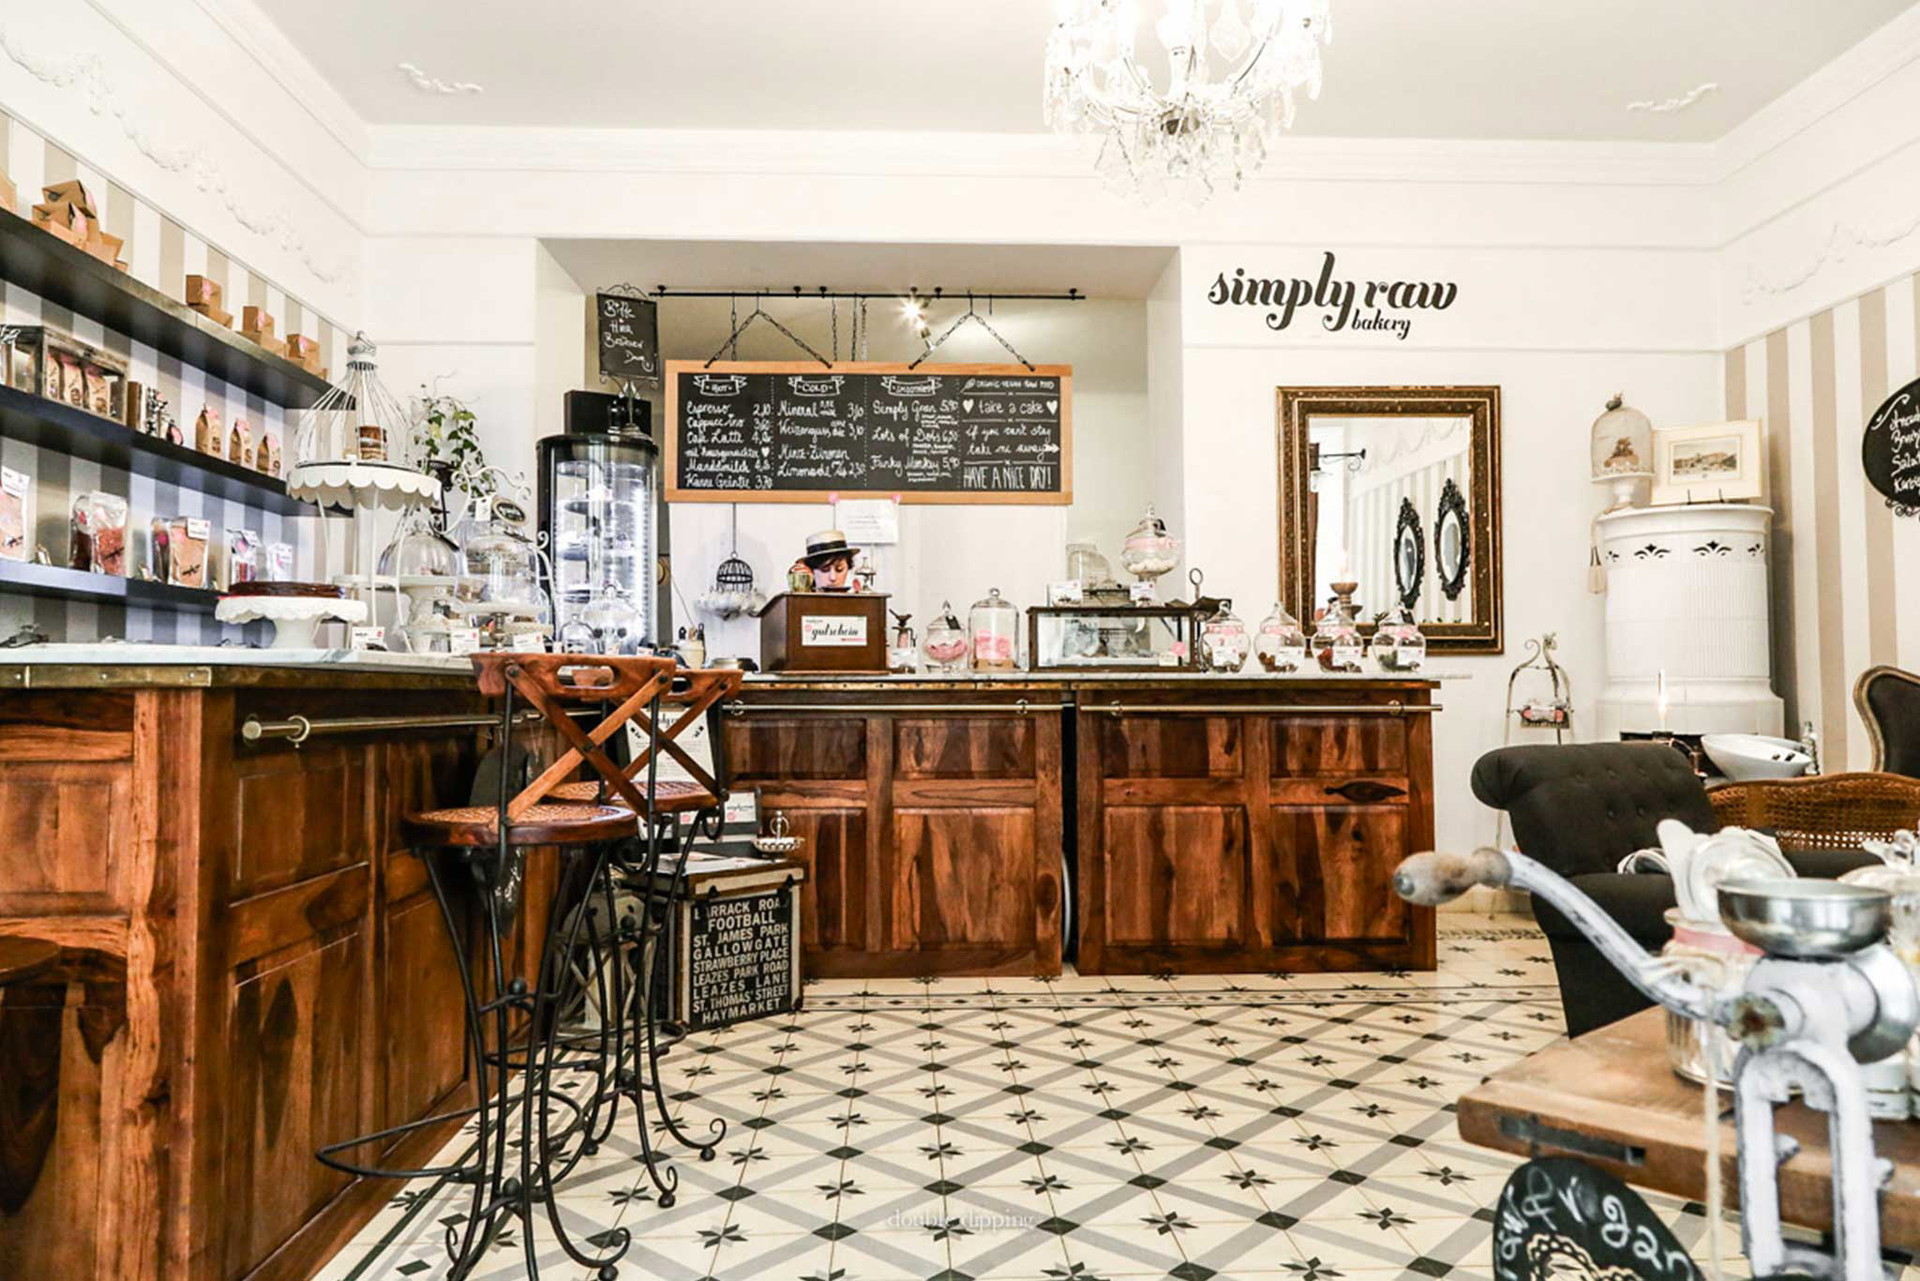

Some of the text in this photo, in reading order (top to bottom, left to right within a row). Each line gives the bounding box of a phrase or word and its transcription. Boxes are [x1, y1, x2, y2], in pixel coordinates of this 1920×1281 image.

[1208, 251, 1458, 332] simply raw
[1351, 308, 1412, 341] bakery
[802, 383, 828, 393] COLD
[686, 400, 732, 419] Espresso
[777, 400, 819, 418] Mineral
[872, 400, 908, 421] Simply
[978, 400, 1045, 414] take a cake
[872, 426, 895, 442] Lots
[898, 427, 909, 448] of
[965, 425, 978, 441] if
[981, 428, 1000, 442] you
[1030, 424, 1052, 444] stay
[967, 443, 992, 456] take
[994, 444, 1012, 454] me
[1016, 443, 1047, 463] away
[963, 465, 989, 489] HAVE
[991, 465, 1002, 489] A
[1003, 465, 1025, 489] NICE
[1029, 465, 1051, 490] DAY!
[758, 898, 785, 911] ROA
[708, 911, 775, 932] FOOTBALL
[693, 923, 788, 947] ST. JAMES PARK
[693, 935, 789, 960] GALLOWGATE
[693, 946, 789, 974] STRAWBERRY PLACE
[693, 960, 789, 987] LEAZES PARK ROAD
[693, 972, 789, 1000] LEAZES LANE
[693, 1000, 708, 1013] ST.
[755, 984, 788, 1000] STREET
[702, 998, 781, 1024] HAYMARKET
